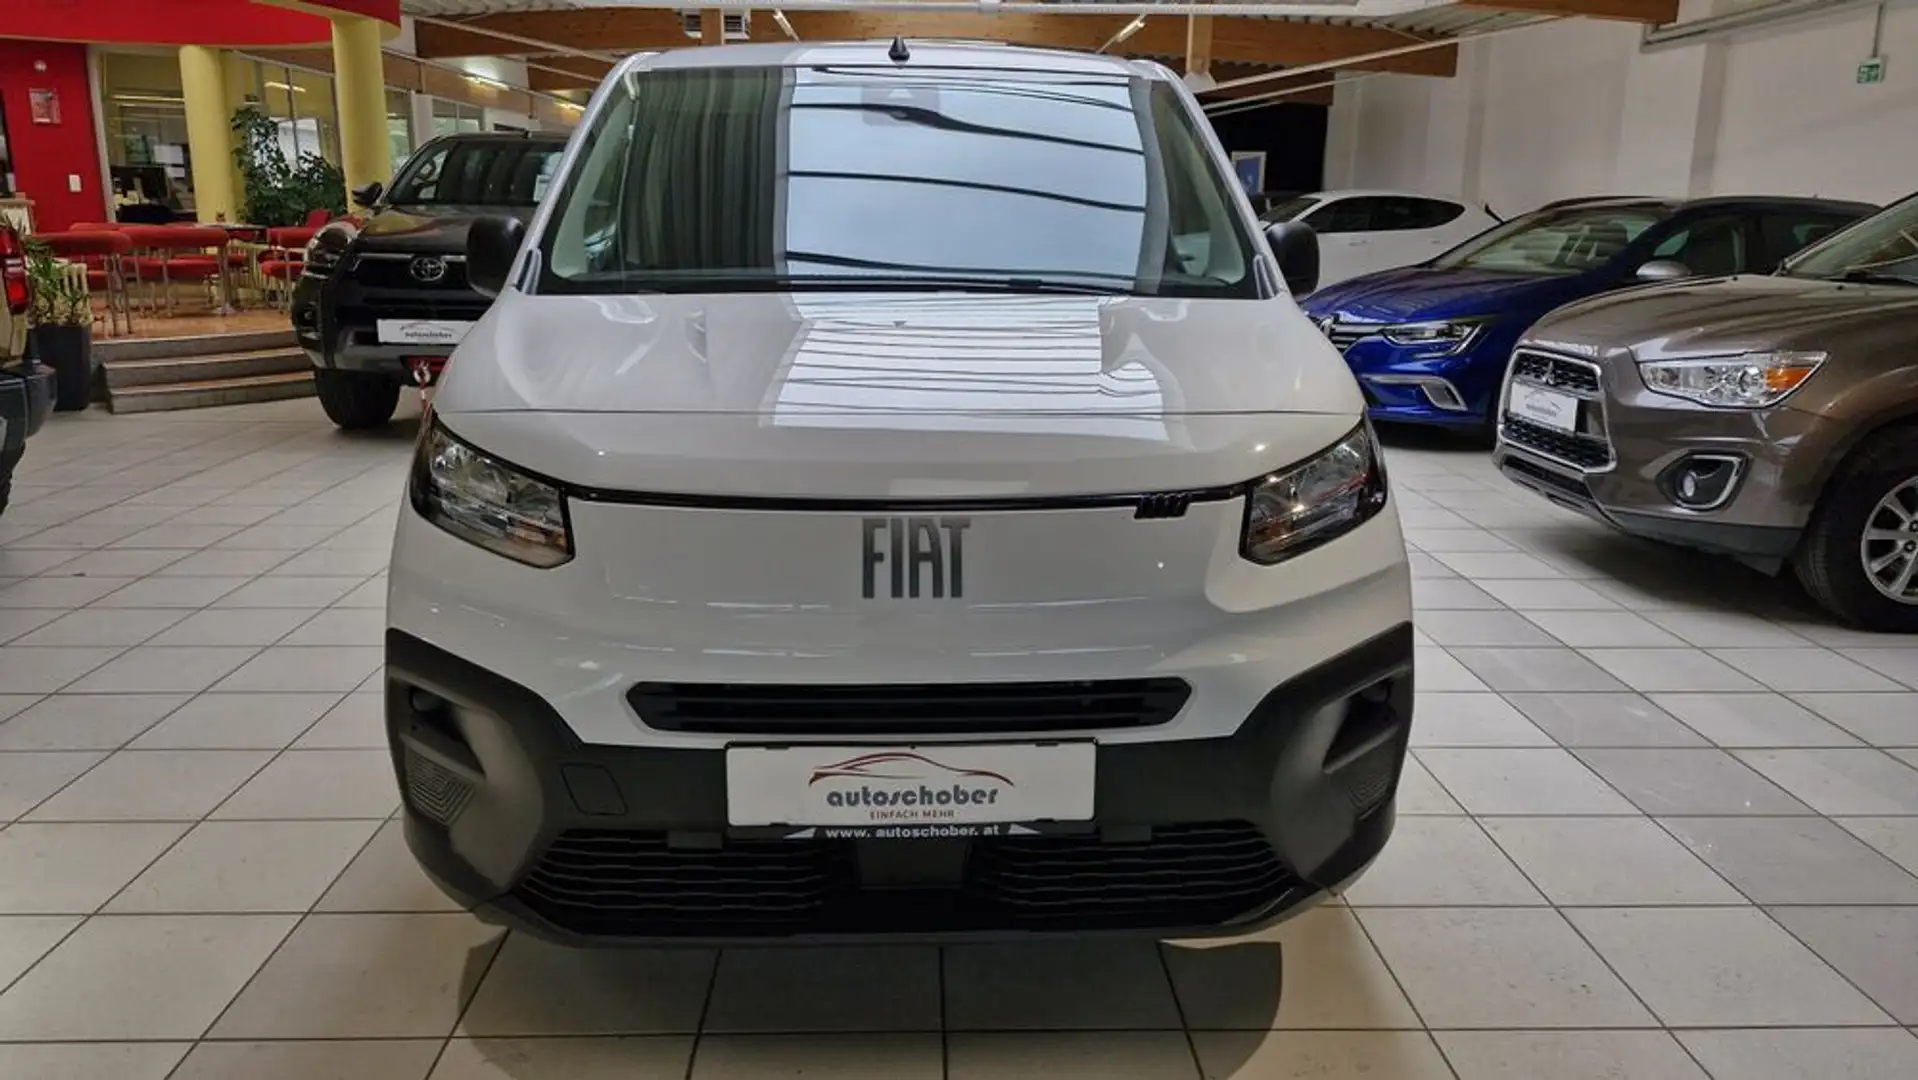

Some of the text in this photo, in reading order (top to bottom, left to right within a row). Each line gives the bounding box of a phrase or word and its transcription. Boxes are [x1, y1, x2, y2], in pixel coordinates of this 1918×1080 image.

[862, 517, 971, 599] FIAT
[826, 785, 999, 807] autoschober
[869, 809, 955, 821] EINFACH MEHR
